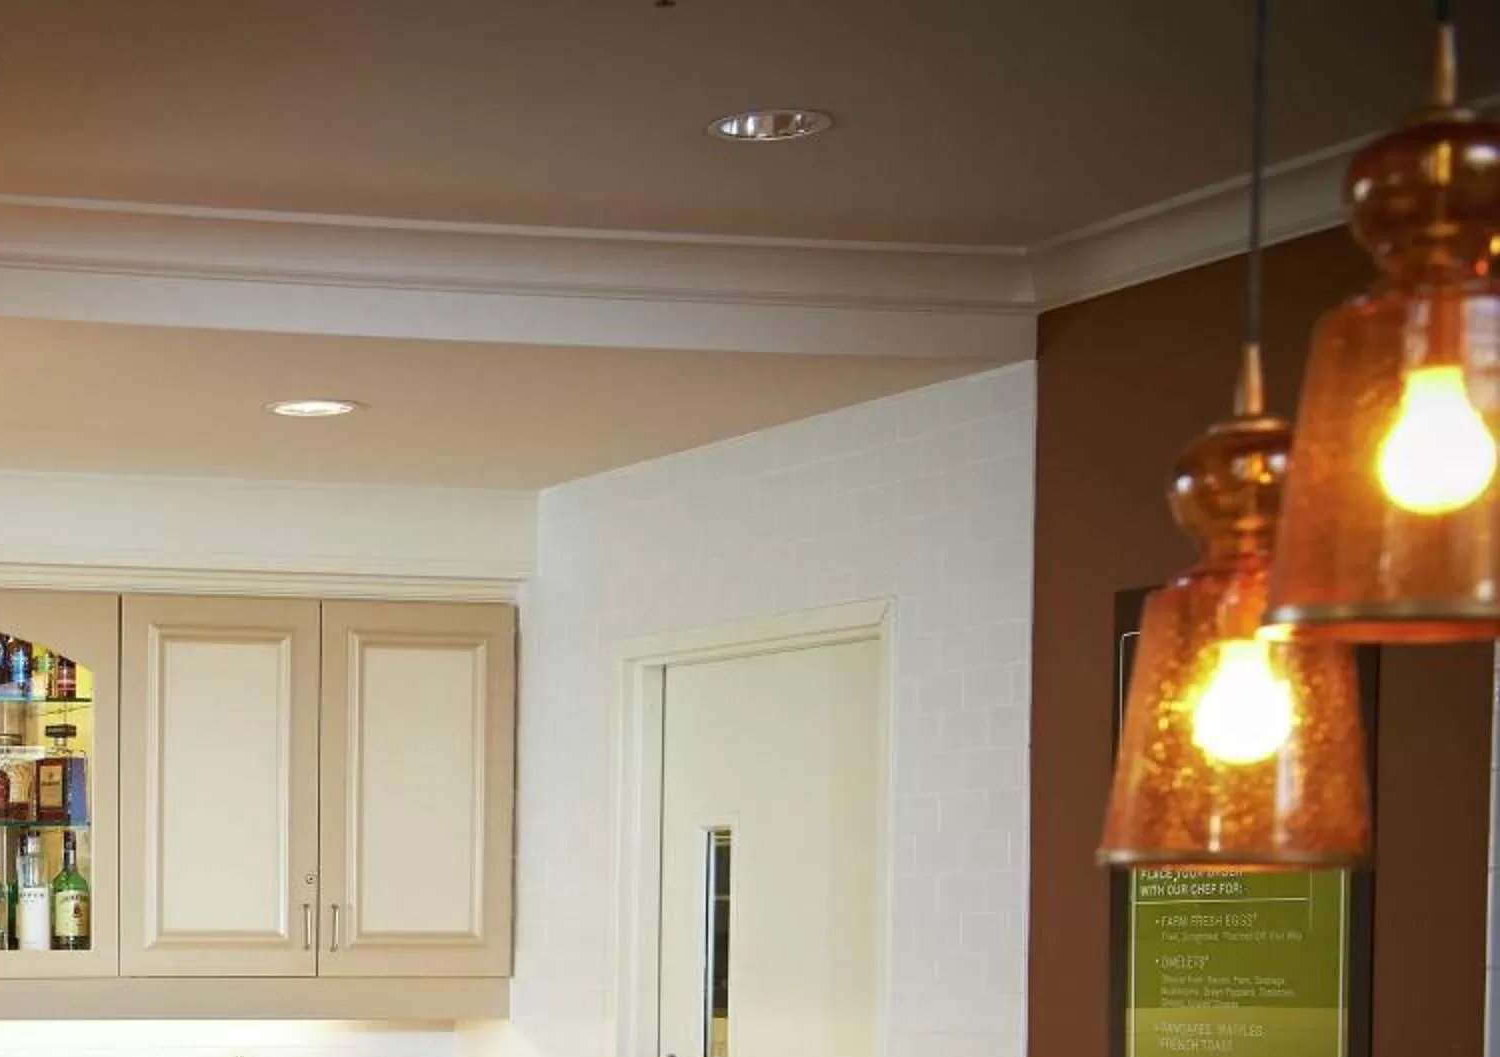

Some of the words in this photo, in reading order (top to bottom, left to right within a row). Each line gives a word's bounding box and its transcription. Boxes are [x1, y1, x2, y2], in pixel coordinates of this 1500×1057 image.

[1140, 884, 1165, 896] WITH
[1168, 884, 1189, 896] OUR
[1191, 883, 1218, 896] CHEF
[1191, 913, 1222, 928] FRESH
